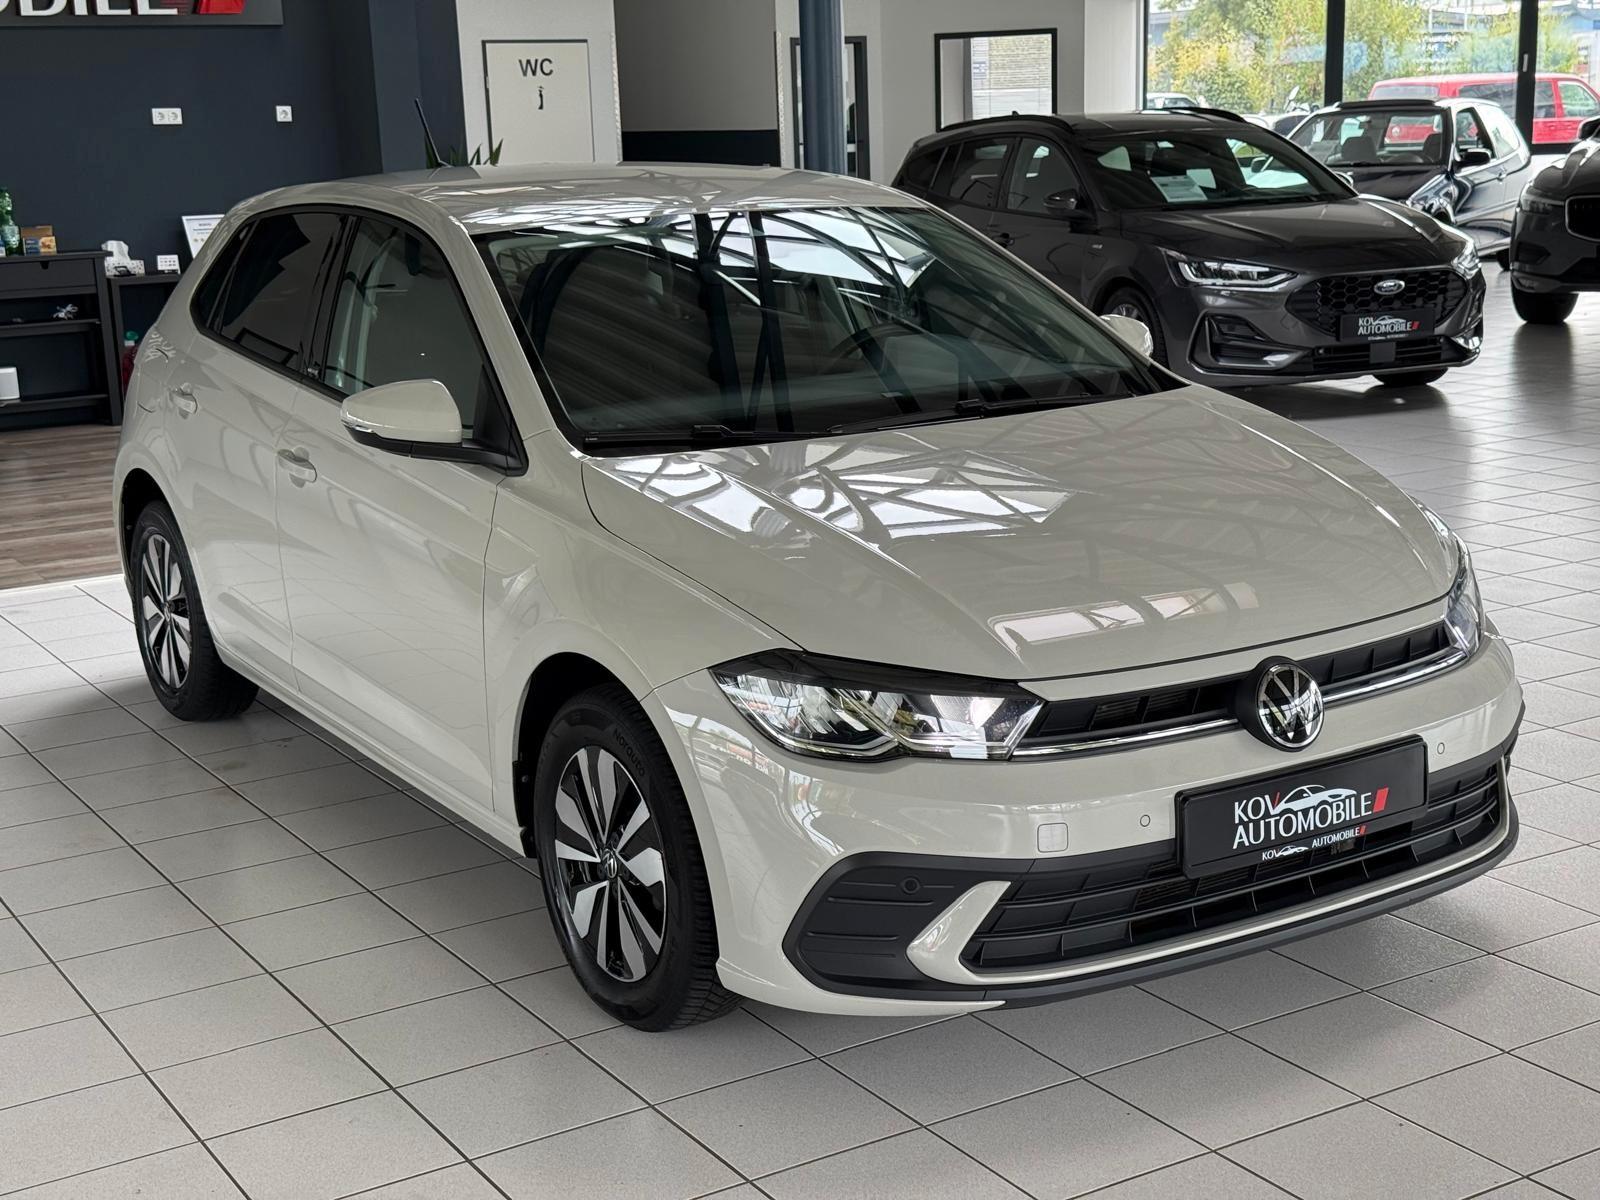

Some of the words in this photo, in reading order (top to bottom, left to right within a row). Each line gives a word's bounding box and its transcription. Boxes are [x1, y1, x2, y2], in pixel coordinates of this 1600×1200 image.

[518, 57, 554, 77] WC
[1357, 321, 1413, 335] AUTOMOBILE
[1232, 791, 1373, 850] AUTOMOBILE
[1234, 792, 1281, 824] KOV
[1262, 849, 1281, 861] KOV
[1311, 827, 1361, 849] AUTOMOBILE
